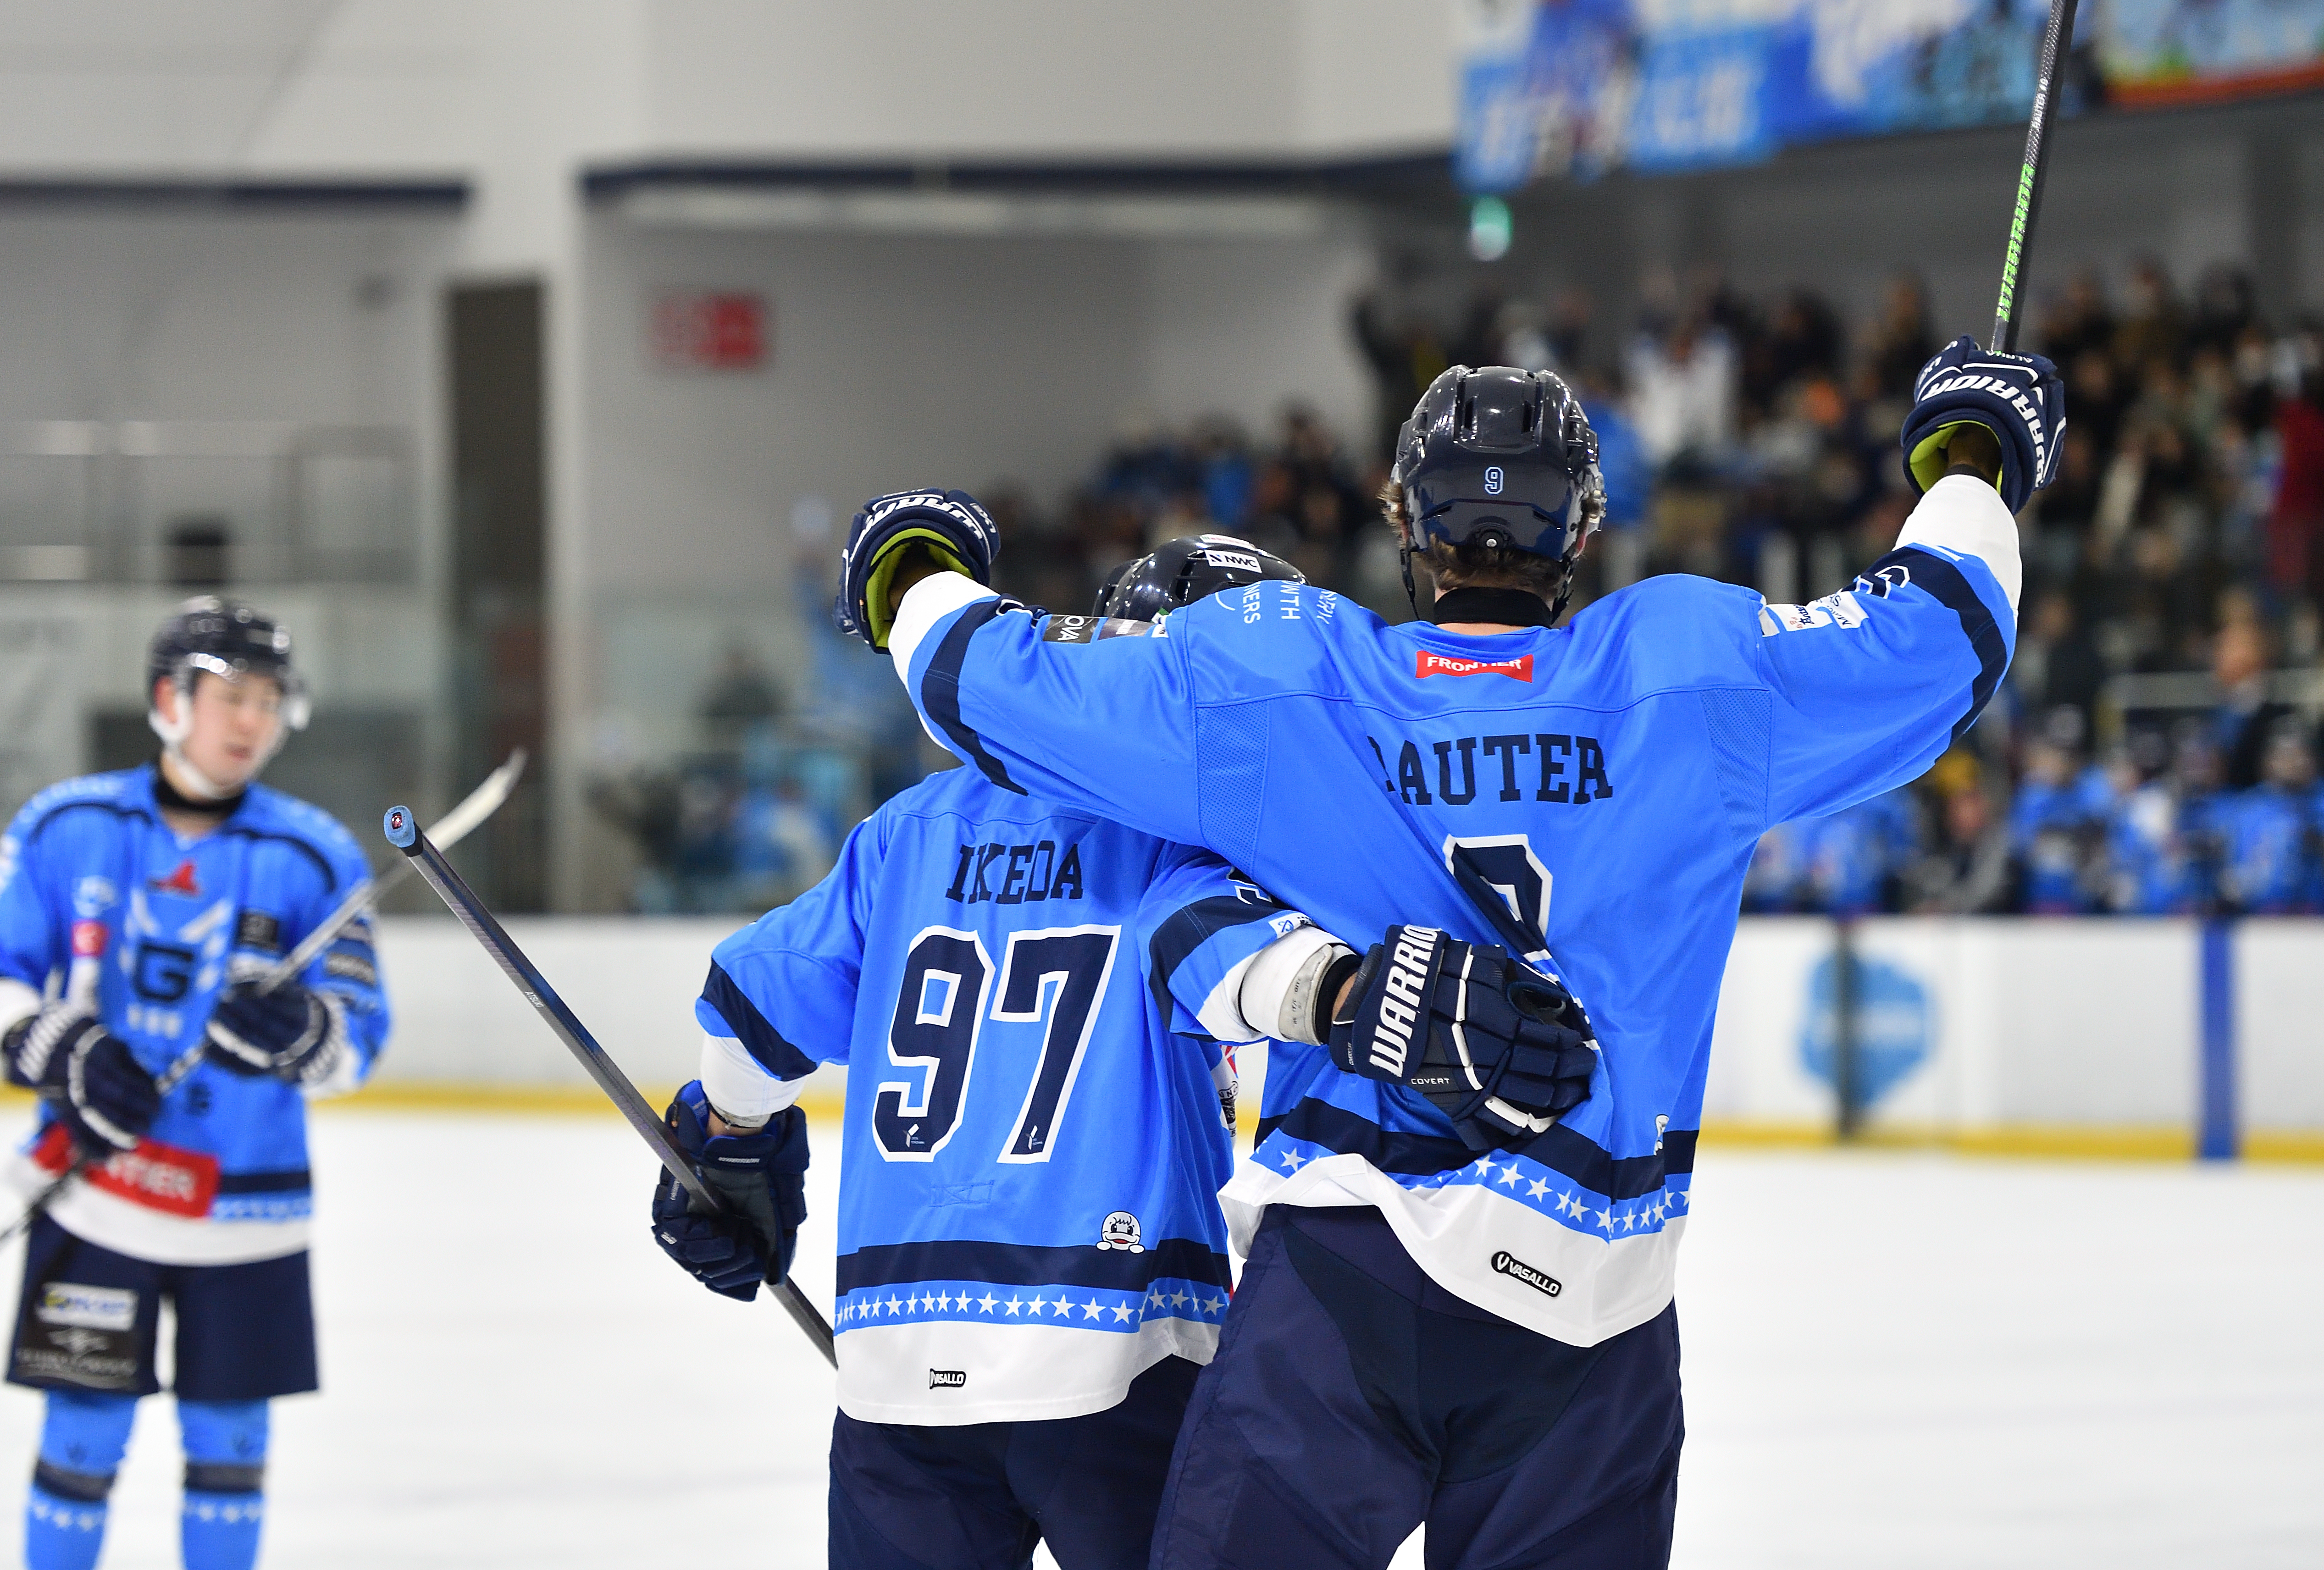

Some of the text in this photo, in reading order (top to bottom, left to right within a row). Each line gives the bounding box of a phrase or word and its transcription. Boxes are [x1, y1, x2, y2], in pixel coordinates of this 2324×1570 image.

[1996, 163, 2036, 322] WARRIOR
[1922, 375, 2046, 488] WARRIOR
[1484, 467, 1504, 494] 9
[1224, 555, 1257, 567] NWC
[1242, 581, 1262, 624] NERS
[1280, 580, 1301, 619] OWTH
[945, 840, 1083, 905] IKEDA
[524, 990, 543, 1008] ATSUKI
[1369, 923, 1443, 1078] WARRIO
[872, 924, 1122, 1163] 97
[1410, 1077, 1450, 1085] COVERT
[1509, 1260, 1559, 1295] VASALLO
